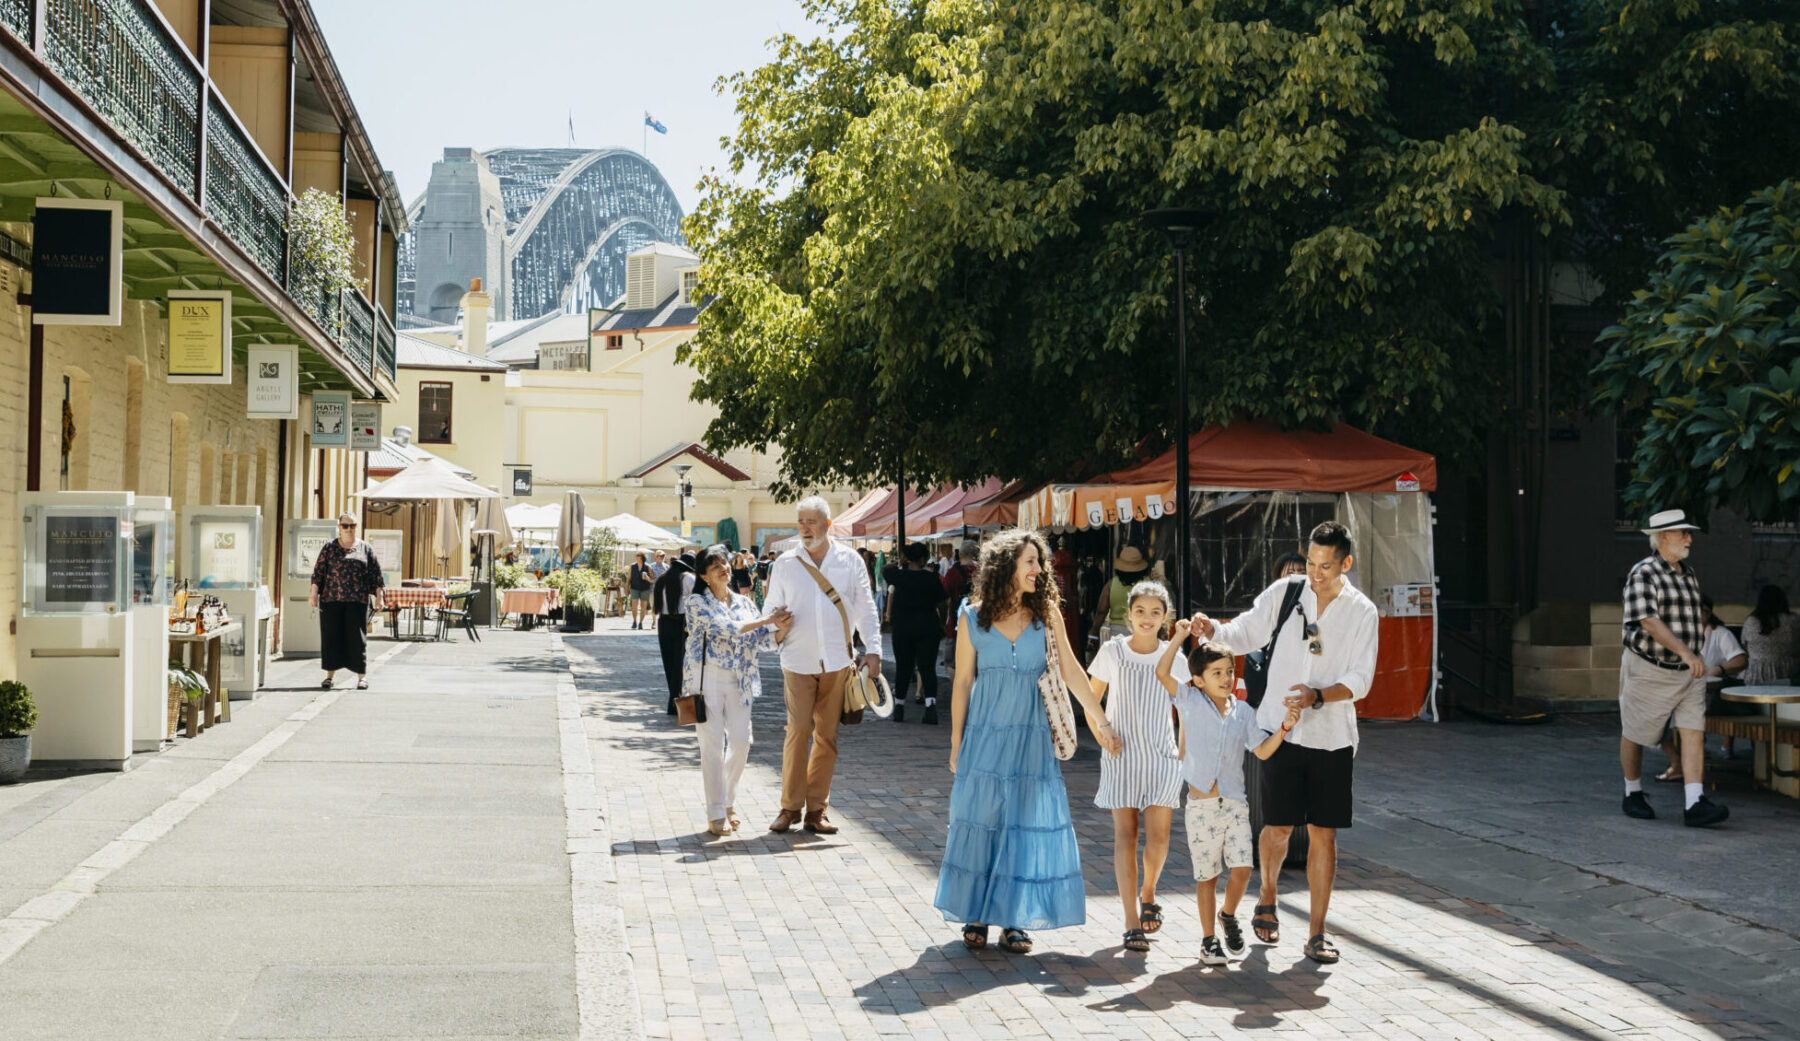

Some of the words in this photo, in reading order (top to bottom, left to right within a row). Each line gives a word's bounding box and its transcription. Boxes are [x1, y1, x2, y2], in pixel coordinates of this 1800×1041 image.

[41, 253, 104, 263] MANCUSO
[182, 306, 209, 315] DUX
[1089, 500, 1175, 524] GELATO
